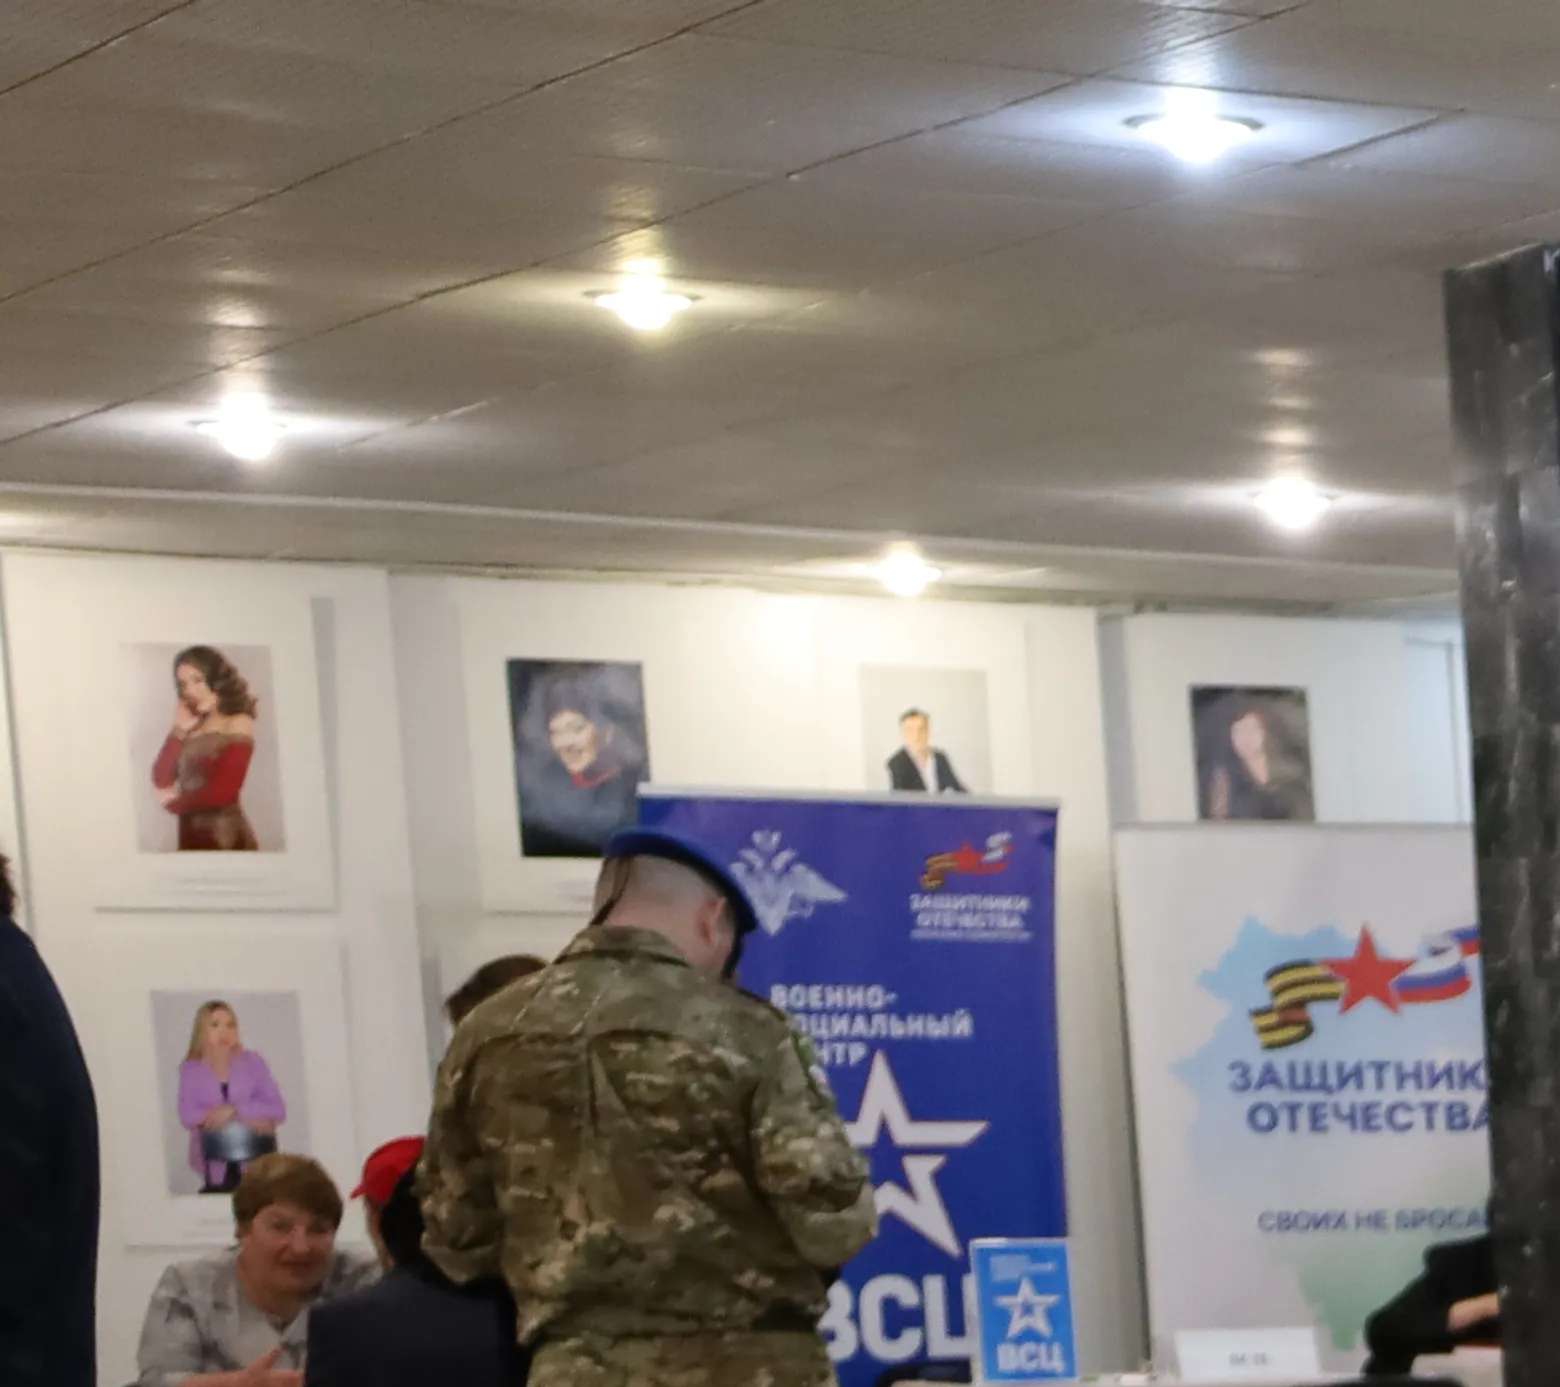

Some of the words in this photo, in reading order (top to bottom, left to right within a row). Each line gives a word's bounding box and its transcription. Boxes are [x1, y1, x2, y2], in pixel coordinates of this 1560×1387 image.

[769, 983, 899, 1010] ВОЕННО-
[793, 1008, 973, 1039] ОЦИАЛЬНЫЙ
[812, 1041, 868, 1066] НТР
[1227, 1058, 1488, 1094] ЗАЩИТНИК
[1354, 1210, 1388, 1230] НЕ
[1394, 1209, 1488, 1230] БРОСА
[996, 1342, 1065, 1373] ВСЦ
